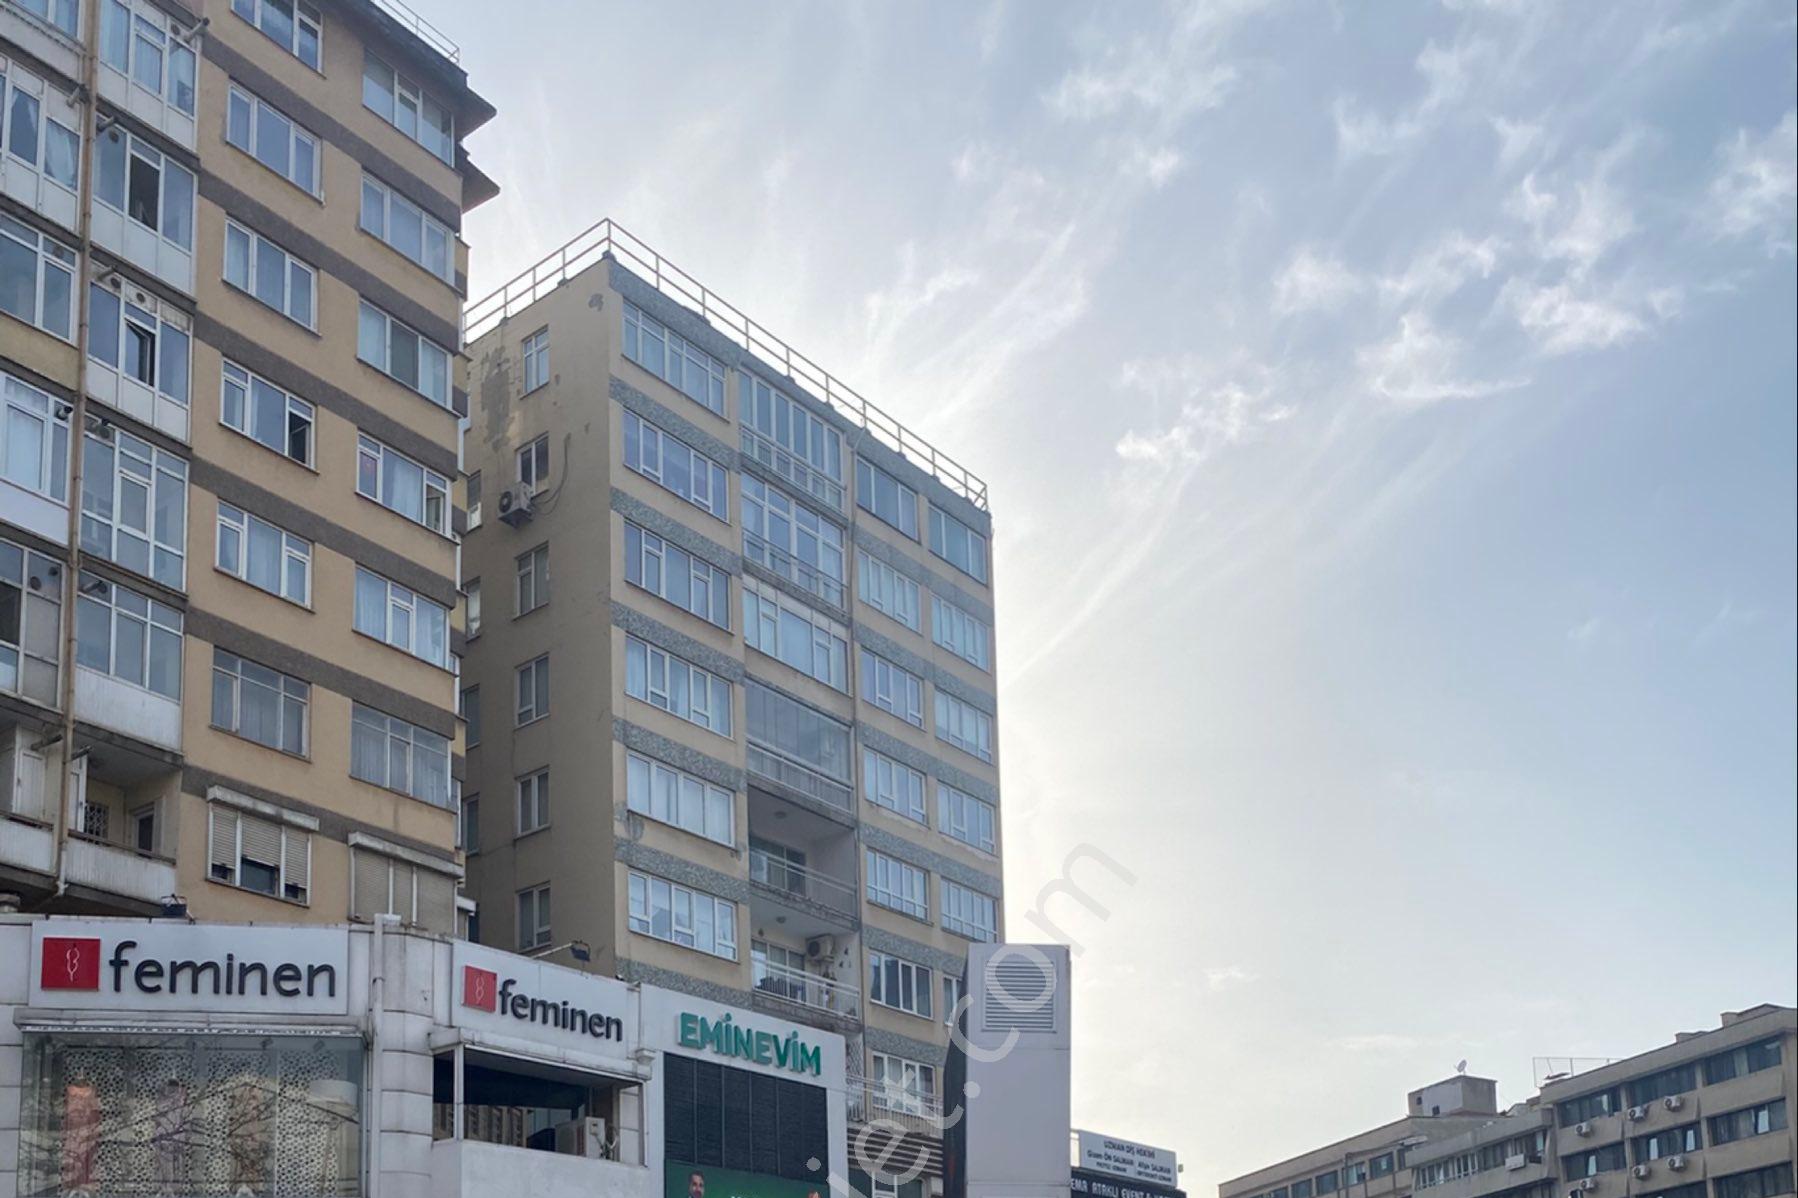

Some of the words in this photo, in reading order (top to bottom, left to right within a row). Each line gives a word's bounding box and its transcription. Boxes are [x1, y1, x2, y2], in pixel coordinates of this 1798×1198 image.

[108, 940, 336, 998] feminen
[498, 978, 624, 1043] feminen
[677, 1012, 822, 1076] EMİNEVİM
